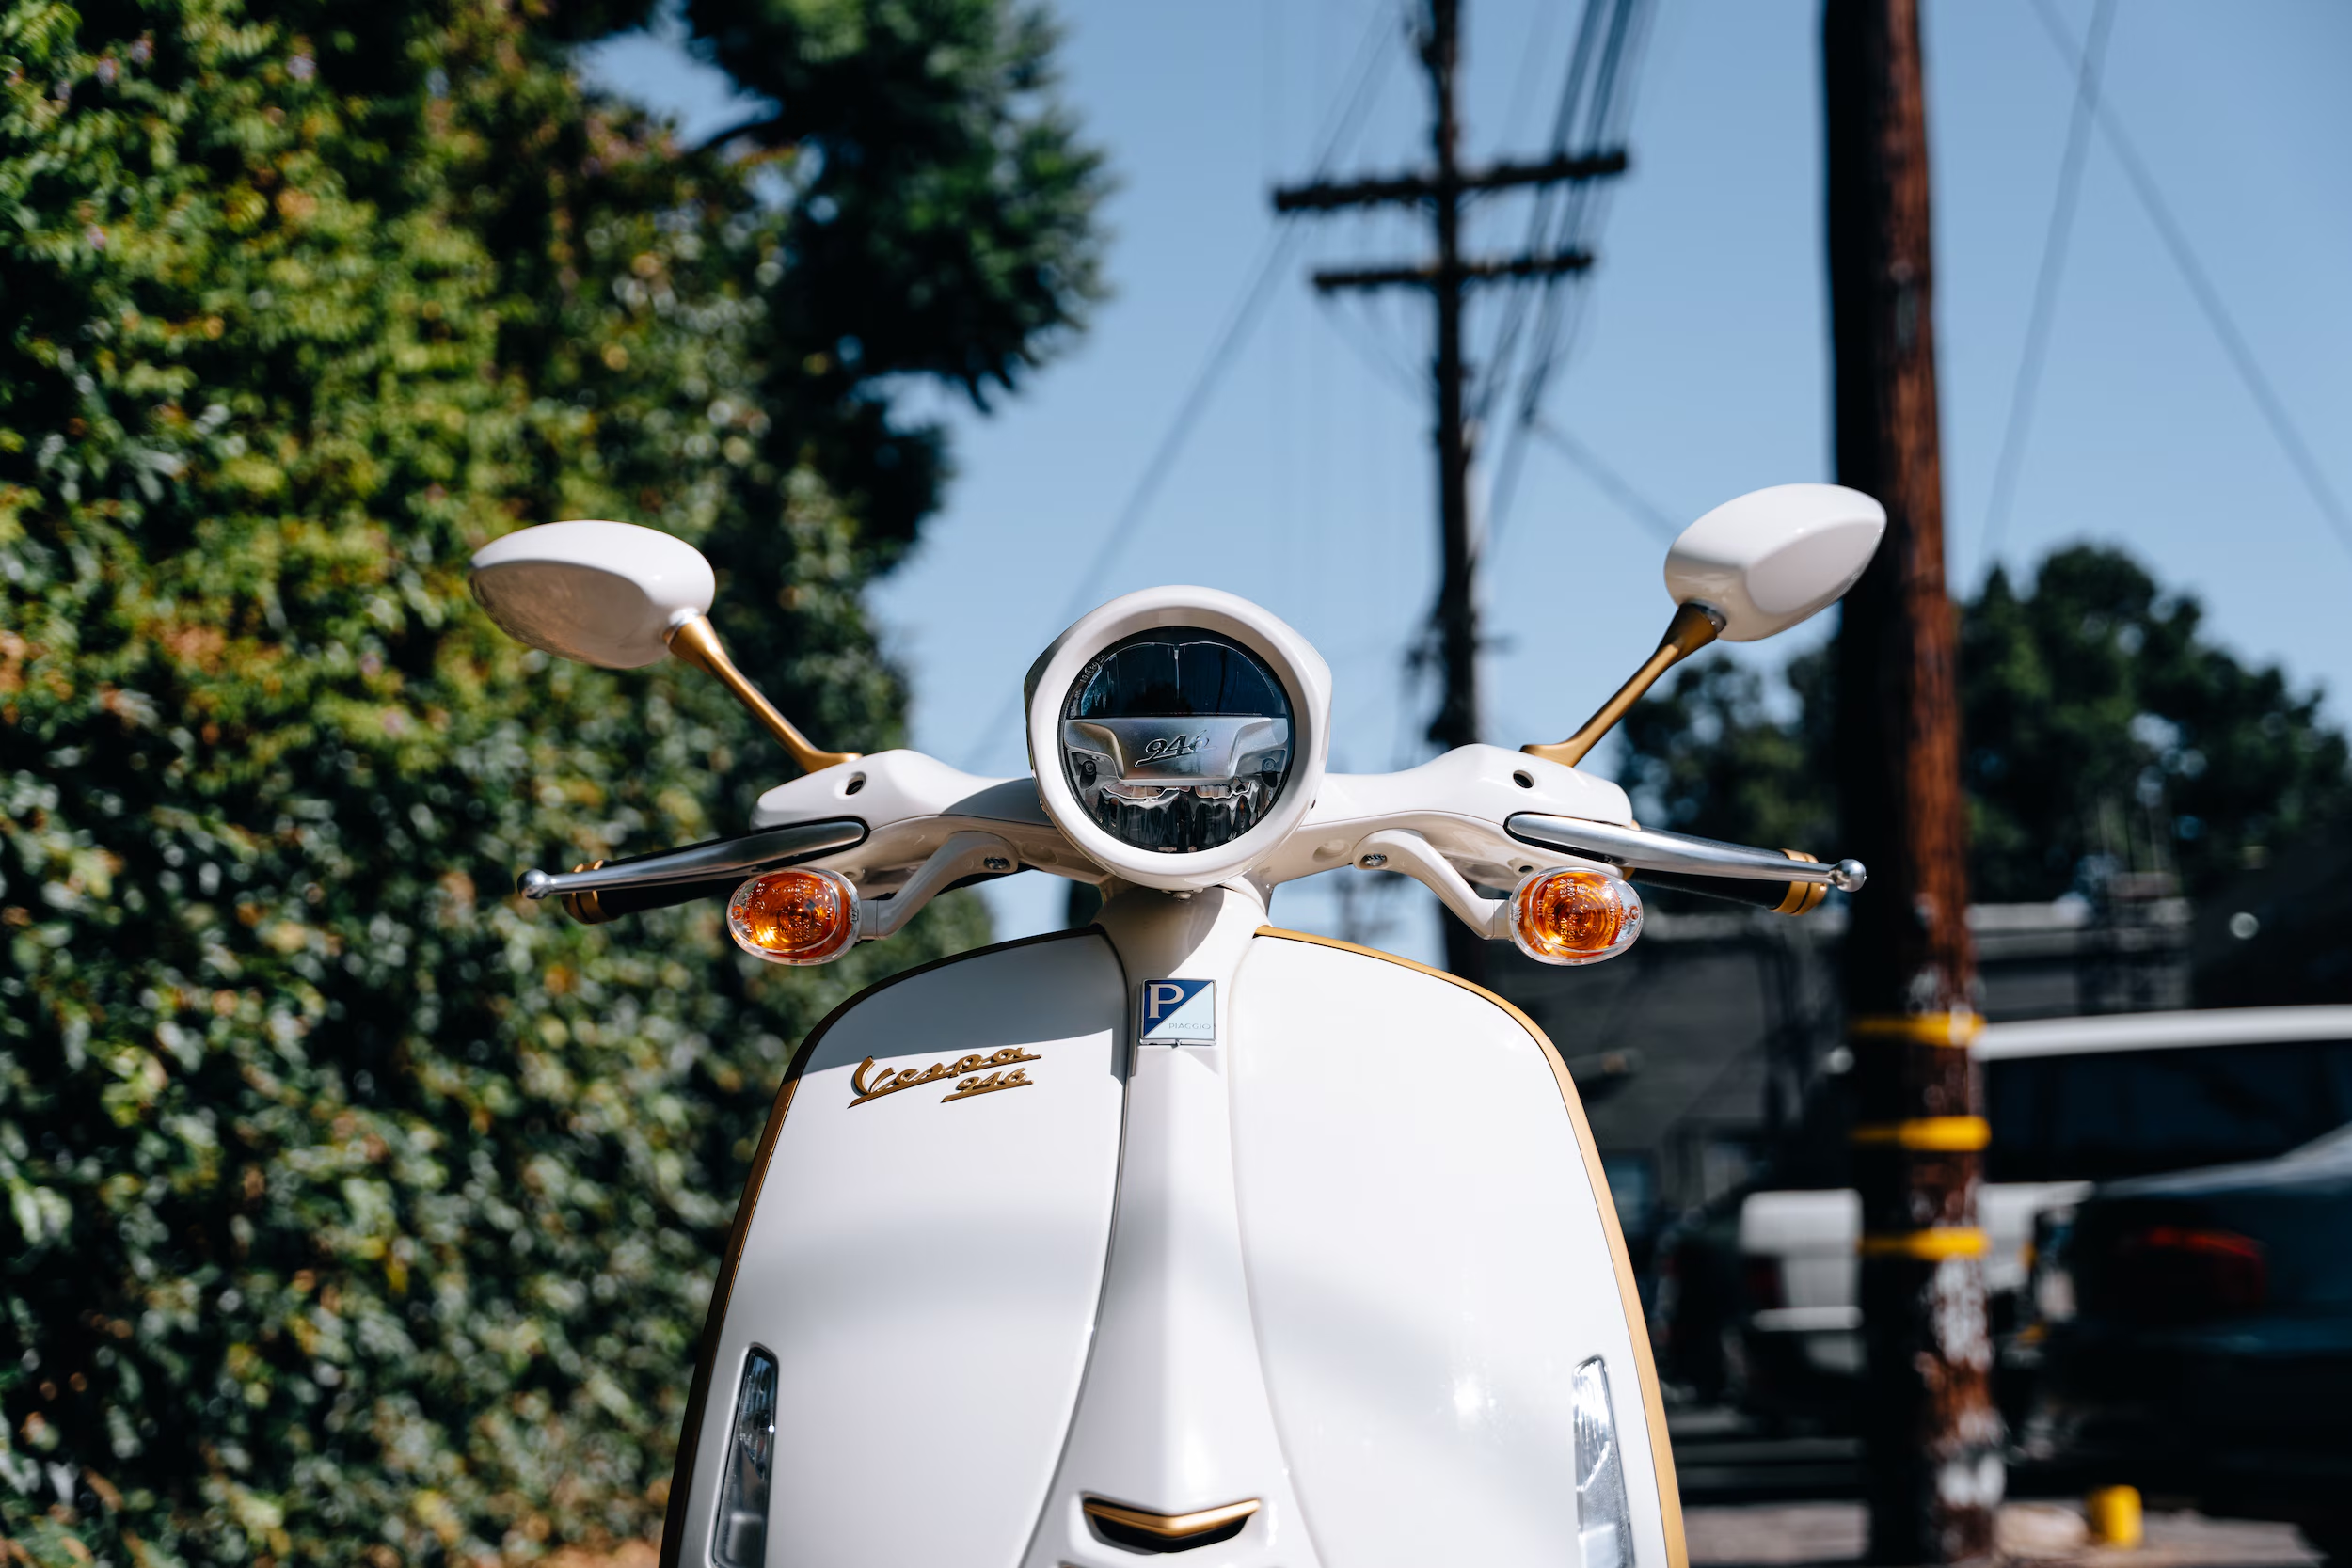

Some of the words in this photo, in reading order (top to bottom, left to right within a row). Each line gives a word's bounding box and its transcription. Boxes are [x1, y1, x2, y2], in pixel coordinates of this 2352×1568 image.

[1135, 729, 1216, 768] 946
[1148, 983, 1184, 1019] P
[848, 1046, 1042, 1108] Vespa
[941, 1067, 1034, 1103] 946
